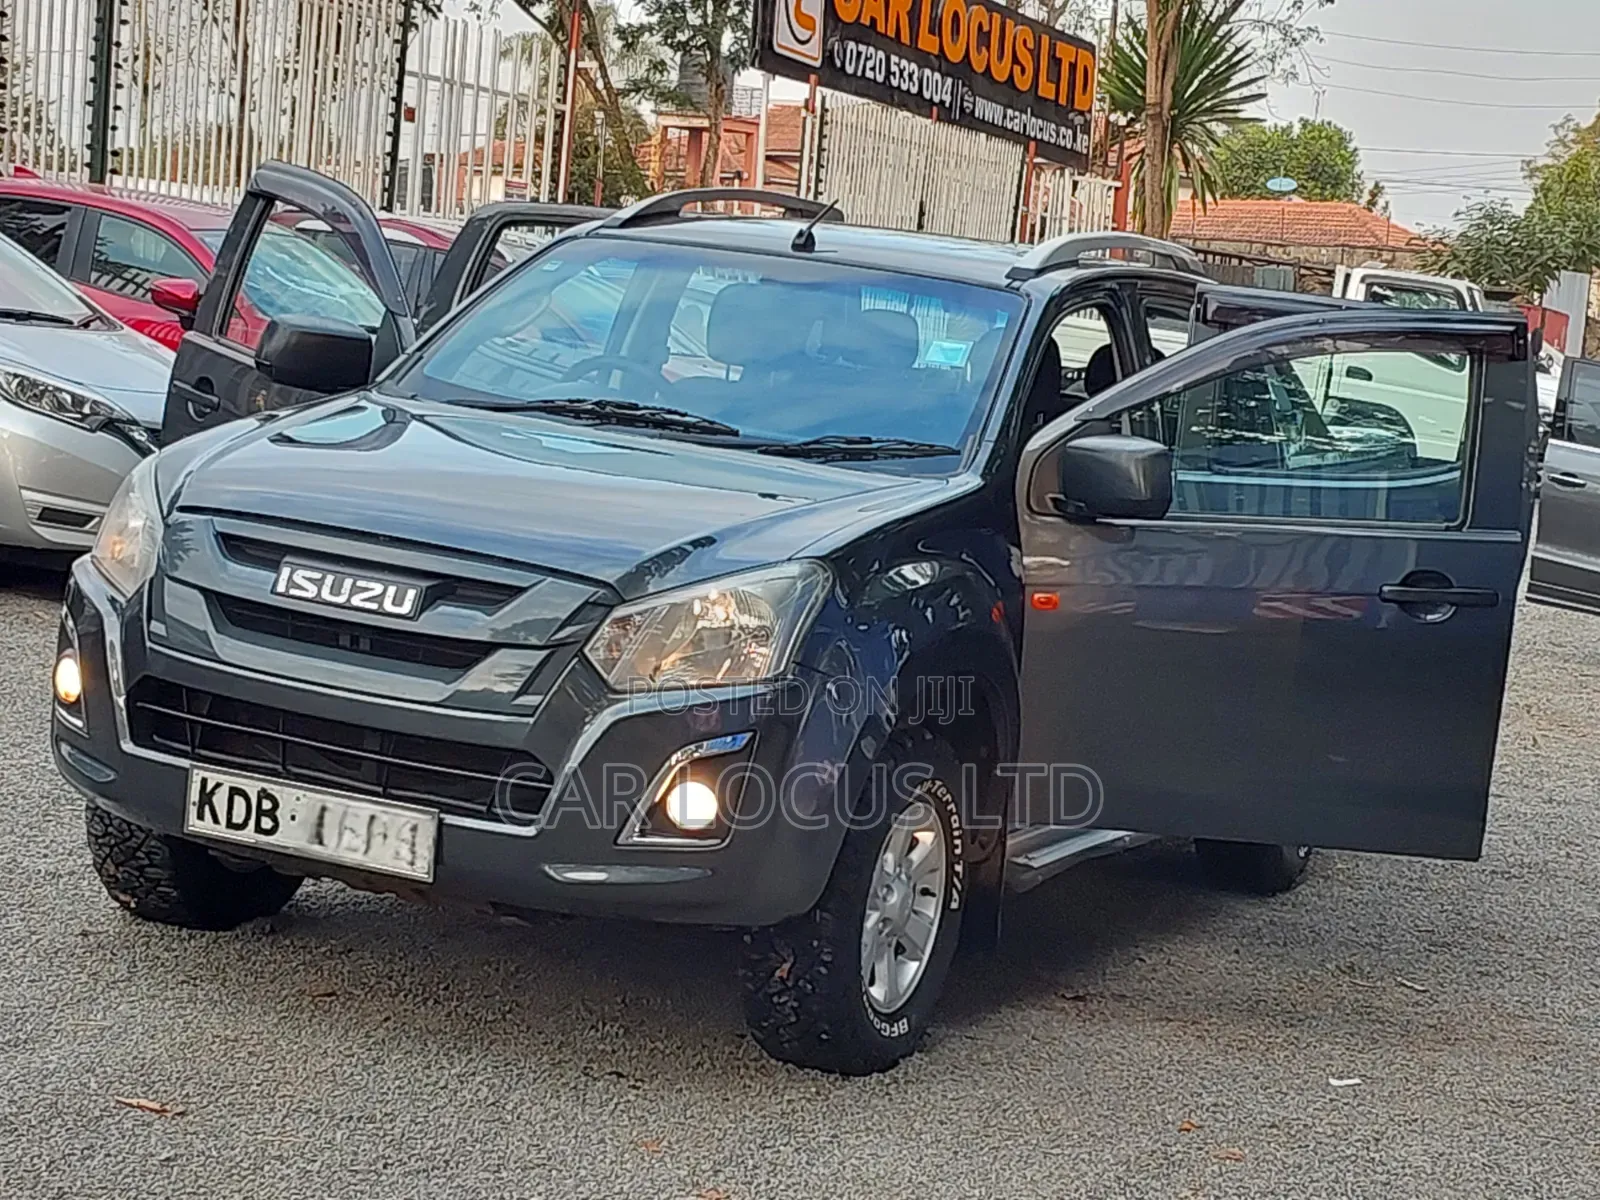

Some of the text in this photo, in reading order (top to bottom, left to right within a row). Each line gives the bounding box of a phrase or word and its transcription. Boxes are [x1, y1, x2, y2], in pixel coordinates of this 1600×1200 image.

[845, 41, 886, 83] 0720
[889, 54, 919, 94] 533
[921, 68, 953, 108] 004
[974, 96, 1089, 154] www.carlocus.co.ke
[917, 0, 1034, 91] LOCUS
[1038, 34, 1094, 111] LTD
[274, 566, 417, 616] ISUZU
[196, 777, 281, 837] KDB
